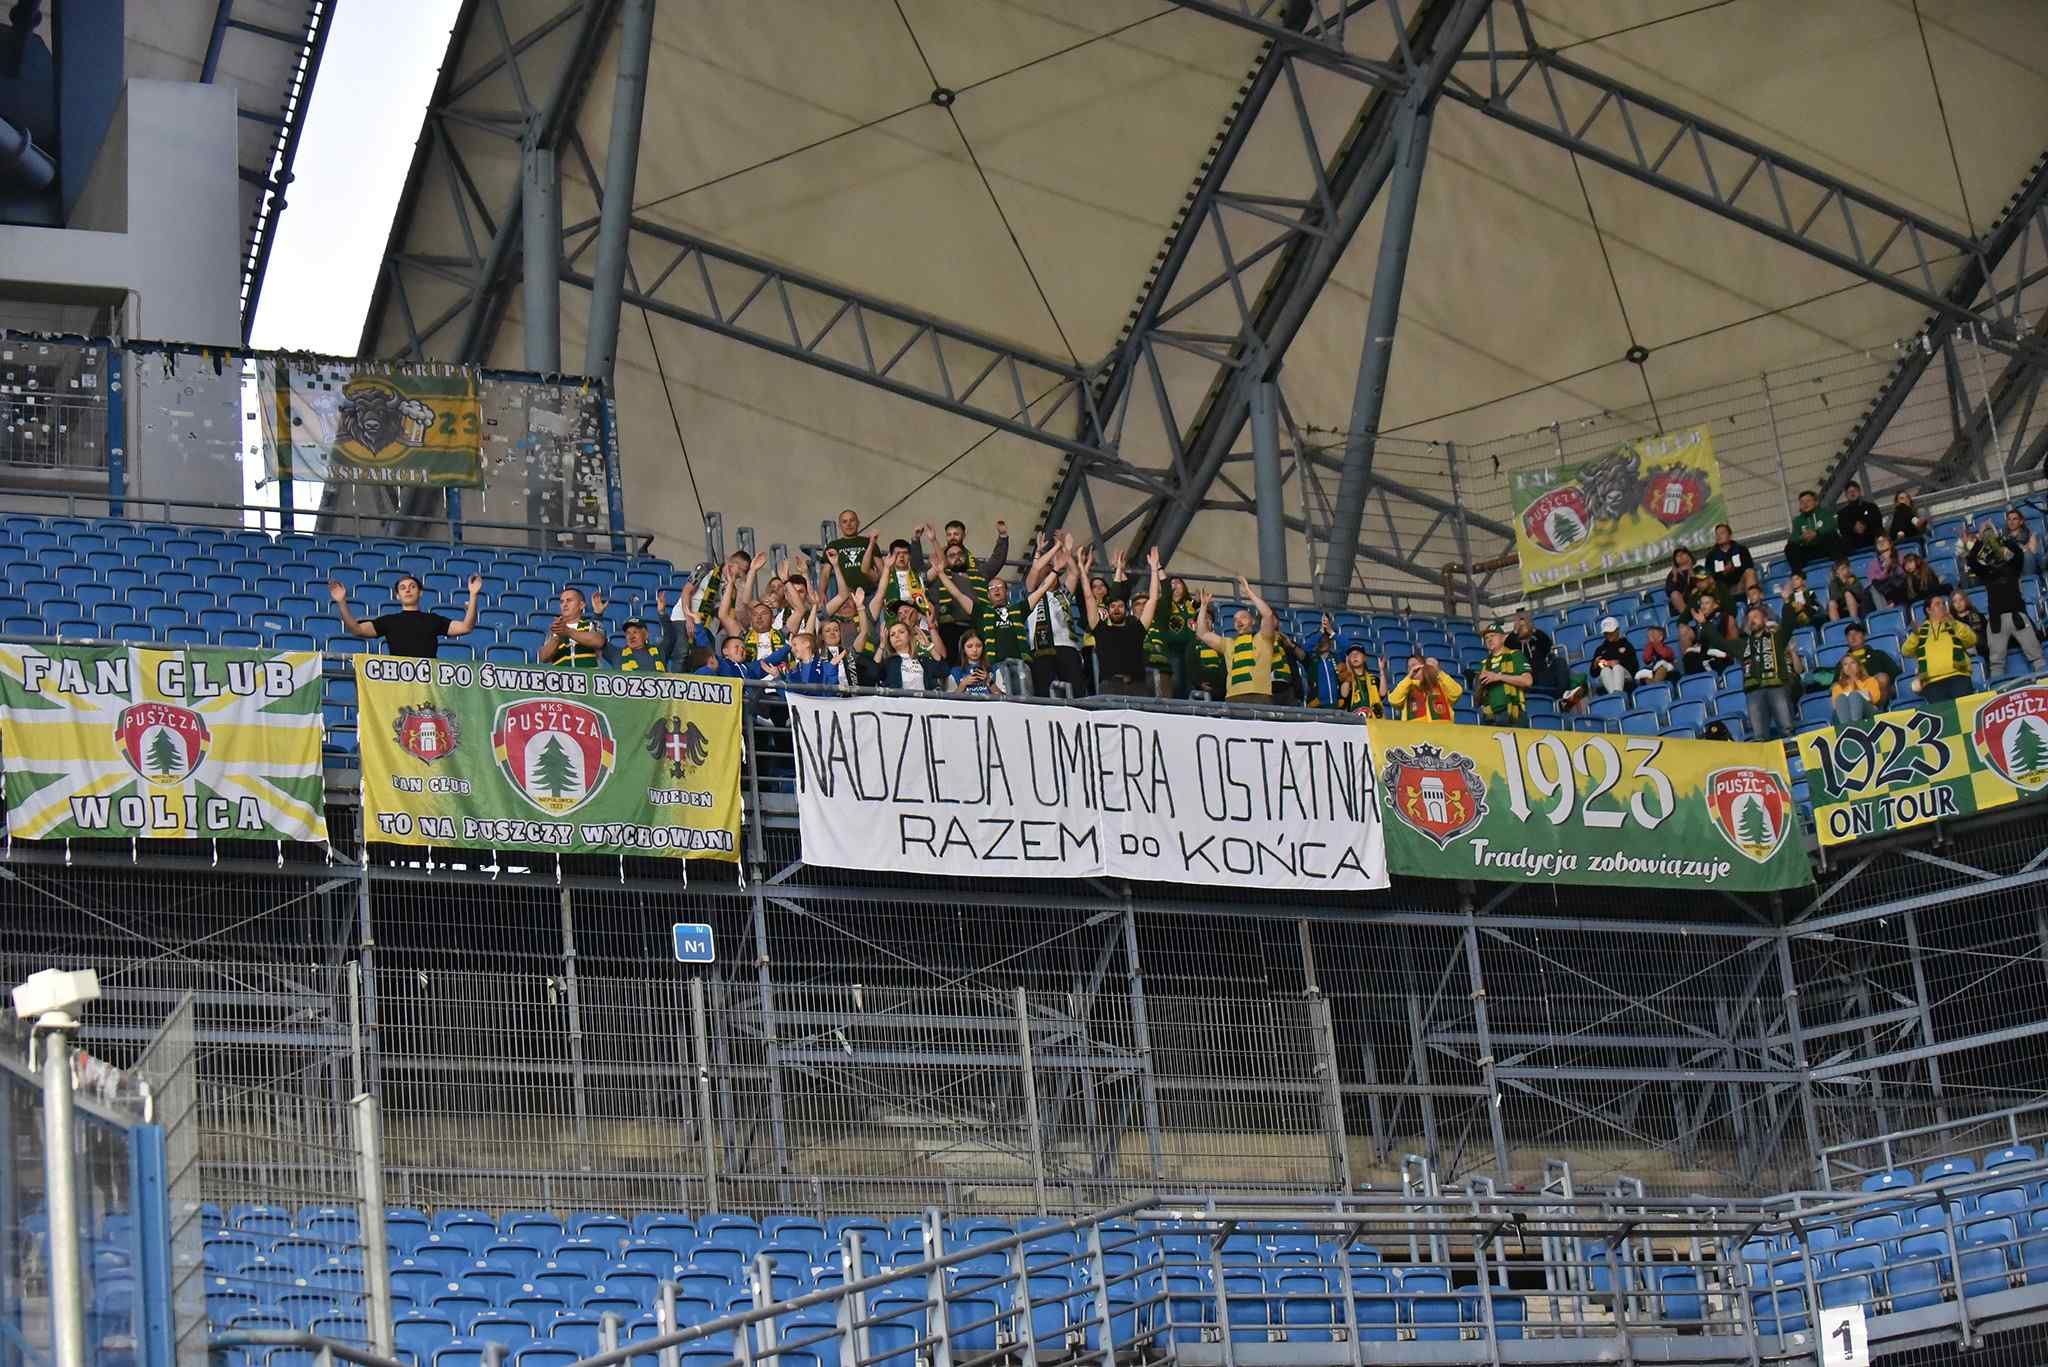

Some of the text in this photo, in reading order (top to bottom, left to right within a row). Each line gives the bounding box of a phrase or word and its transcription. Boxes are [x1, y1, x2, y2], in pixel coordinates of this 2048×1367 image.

[22, 656, 295, 697] FAN CLUB
[366, 660, 732, 704] CHOĆ PO ŚWIECIE ROZSYPANI
[126, 711, 198, 731] PUSZCZA
[507, 712, 599, 738] PUSZCZA
[540, 703, 562, 712] MKS
[1985, 697, 2048, 729] PUSZCZ
[791, 705, 1382, 825] NADZIEJA UMIERA OSTATNIA
[1809, 710, 1952, 799] 1923
[392, 775, 471, 795] FAN CLUB
[649, 788, 713, 808] WIEDEŃ
[1492, 731, 1676, 830] 1923
[1717, 778, 1777, 795] PUSZCA
[70, 795, 264, 830] WOLICA
[1830, 785, 1959, 838] ON TOUR
[378, 812, 734, 851] TO NA PUSZCZY WYCHOWANI
[899, 812, 1370, 880] RAZEM DO KOŃCA
[1469, 838, 1731, 883] Tradycja zobowiązuje
[685, 940, 705, 953] N1
[1832, 1319, 1853, 1360] 1
